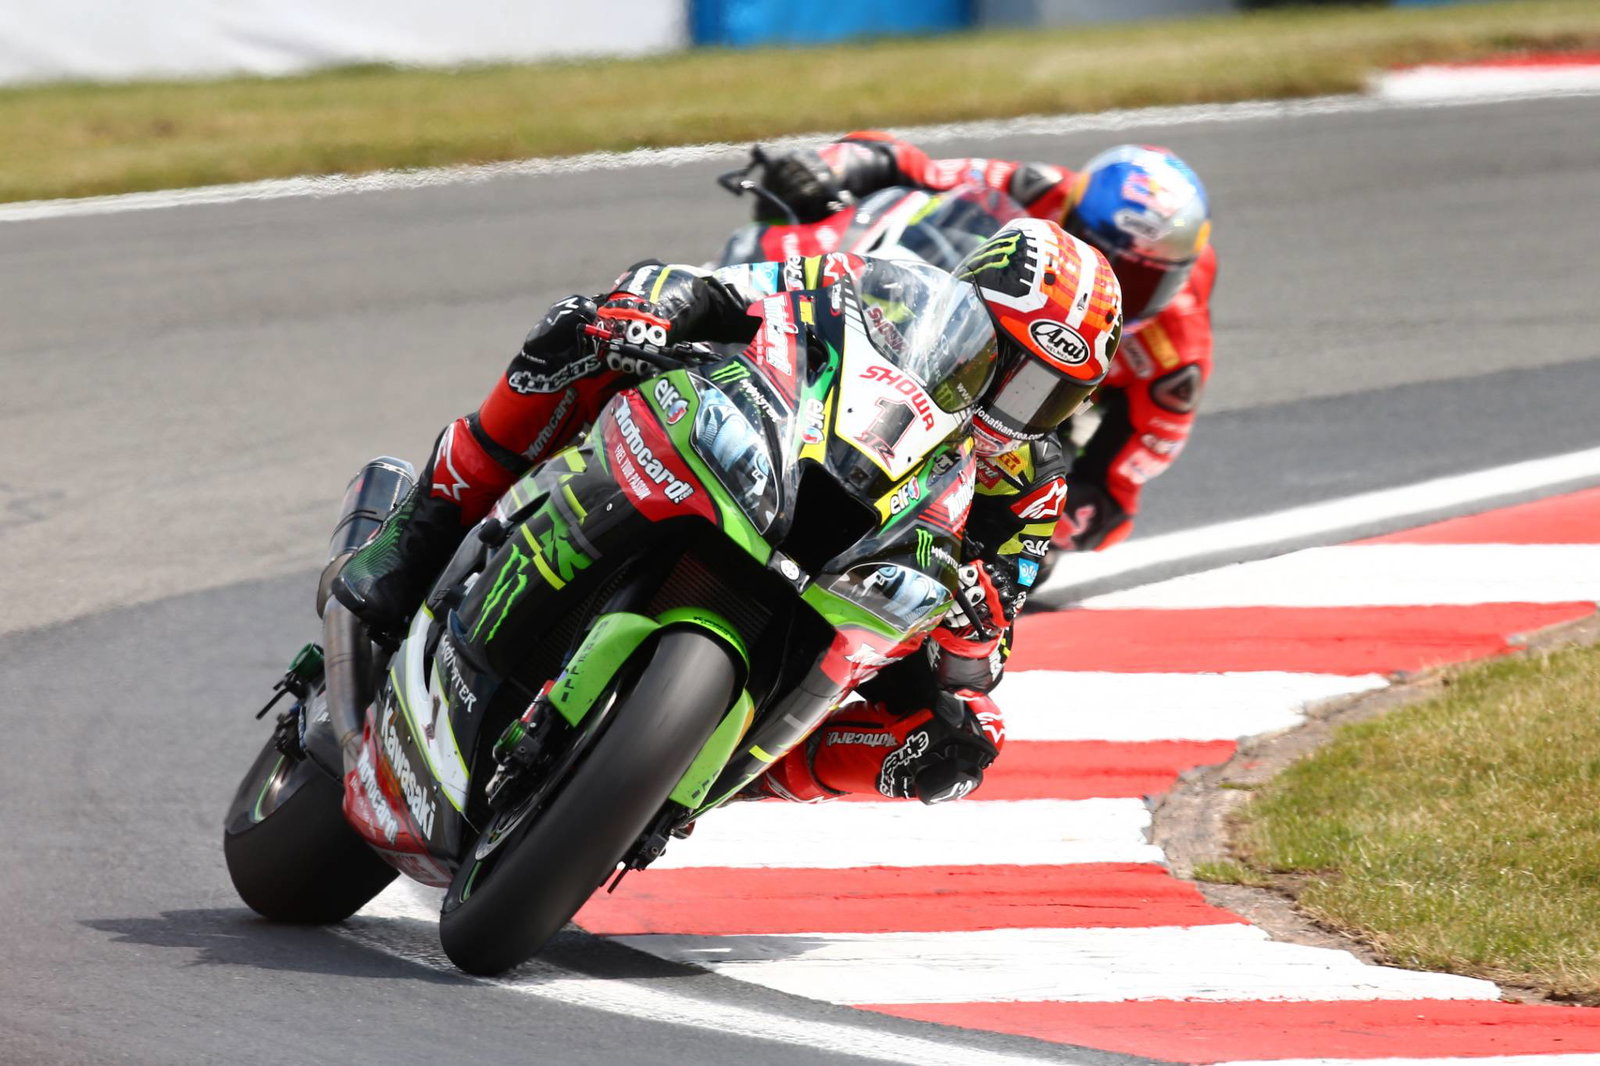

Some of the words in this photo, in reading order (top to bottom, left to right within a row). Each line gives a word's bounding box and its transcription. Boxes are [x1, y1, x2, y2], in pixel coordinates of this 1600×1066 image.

[1035, 327, 1085, 359] Arai
[654, 377, 681, 412] elf
[858, 366, 935, 432] SHOWA
[889, 486, 911, 515] elf
[1022, 539, 1050, 556] elf
[381, 698, 436, 841] Kawasaki
